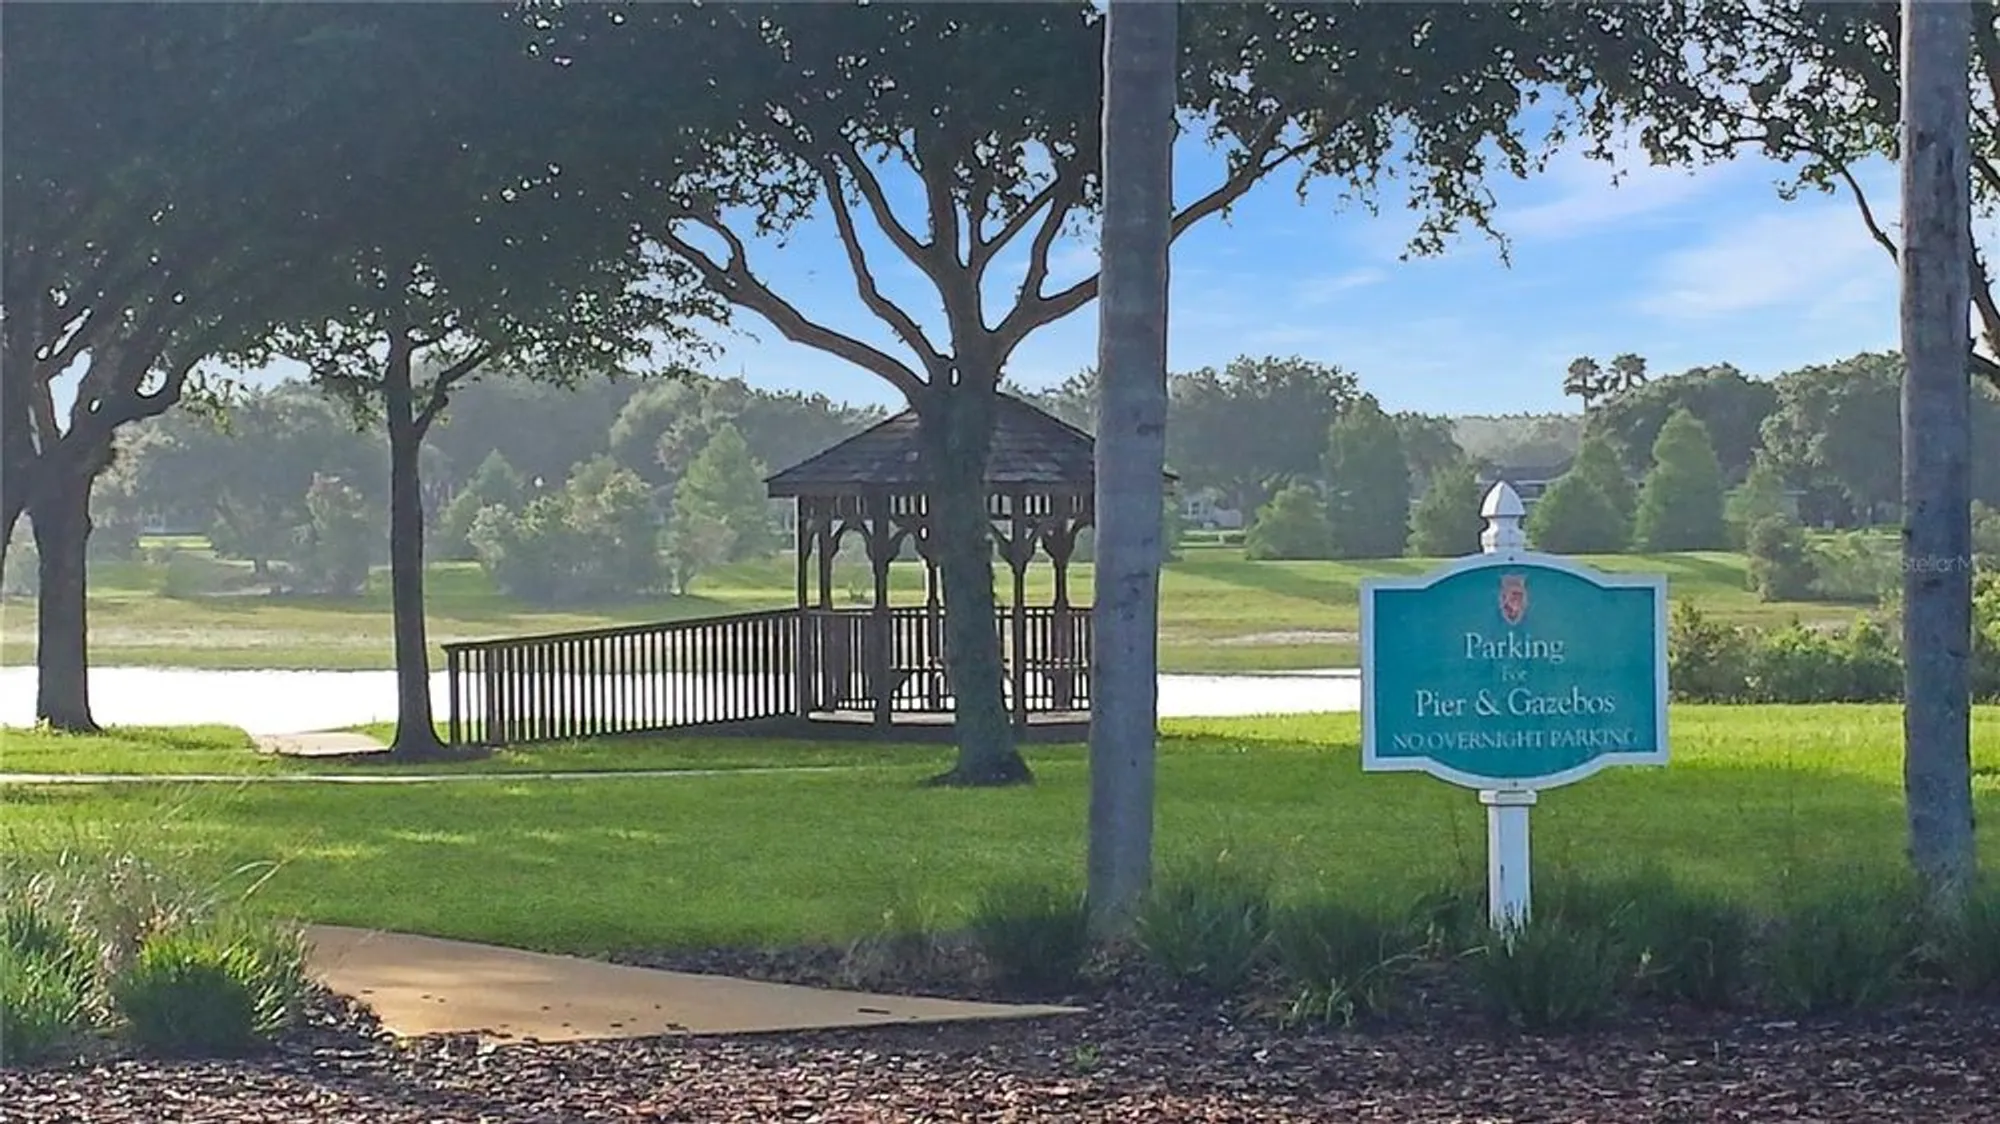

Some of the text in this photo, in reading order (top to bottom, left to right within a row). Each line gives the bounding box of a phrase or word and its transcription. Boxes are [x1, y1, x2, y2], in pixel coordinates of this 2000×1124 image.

[1464, 631, 1565, 662] Parking
[1502, 666, 1527, 682] For
[1416, 686, 1616, 717] Pier & Gazebos
[1391, 727, 1638, 750] NO OVERNIGHT PARKING
